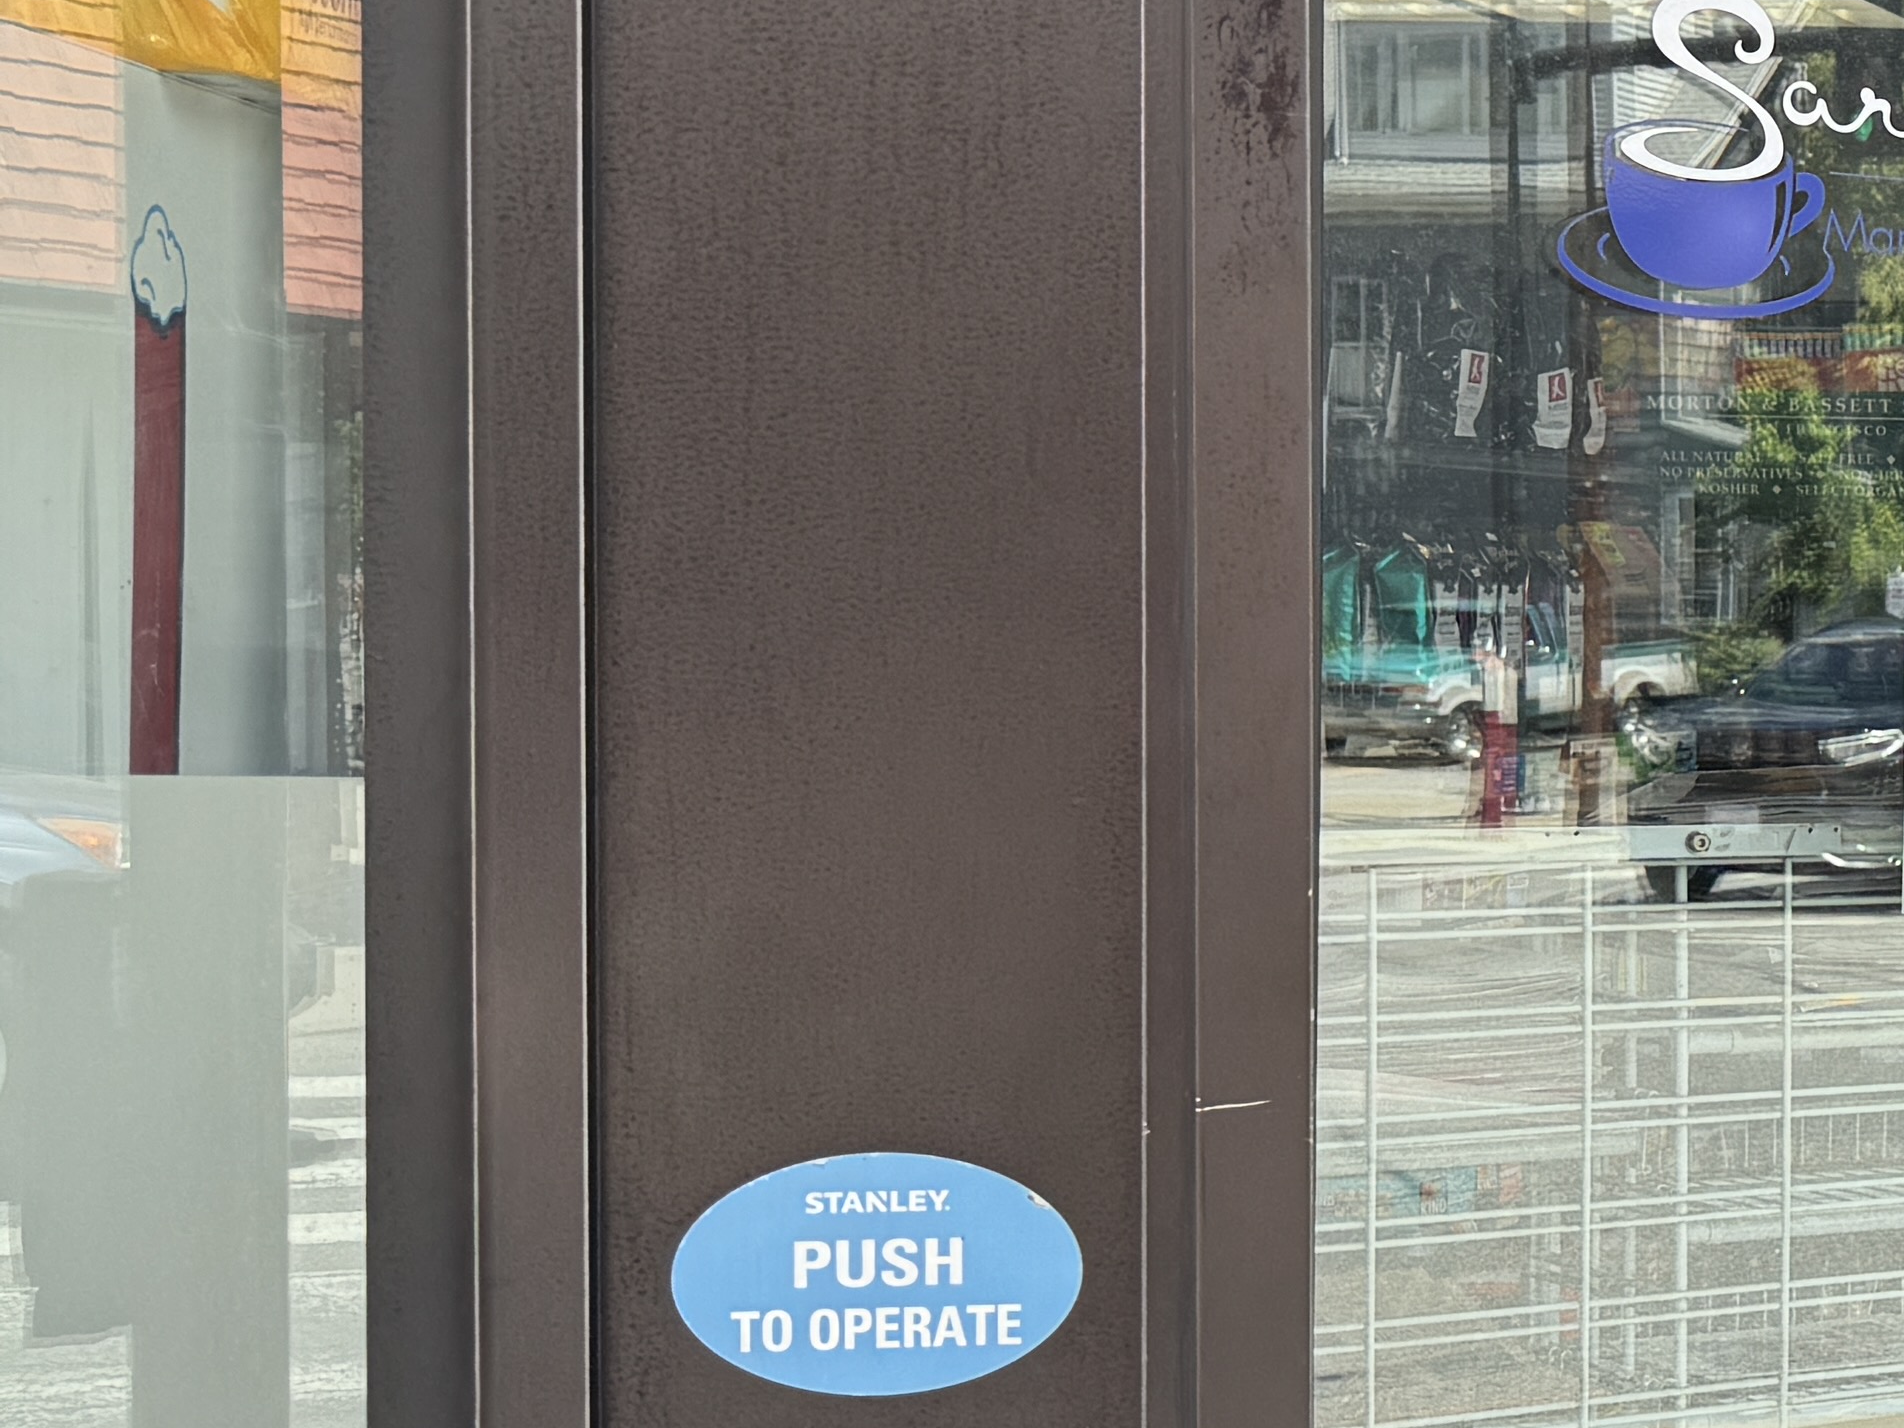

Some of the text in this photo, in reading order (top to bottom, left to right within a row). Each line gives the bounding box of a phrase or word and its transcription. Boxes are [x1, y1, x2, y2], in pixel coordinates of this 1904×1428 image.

[1647, 395, 1750, 412] MORTON
[1788, 397, 1894, 415] BASSETT
[1660, 466, 1683, 478] NO
[804, 1189, 949, 1214] STANLEY
[793, 1236, 964, 1289] PUSH
[730, 1303, 1022, 1353] TO OPERATE
